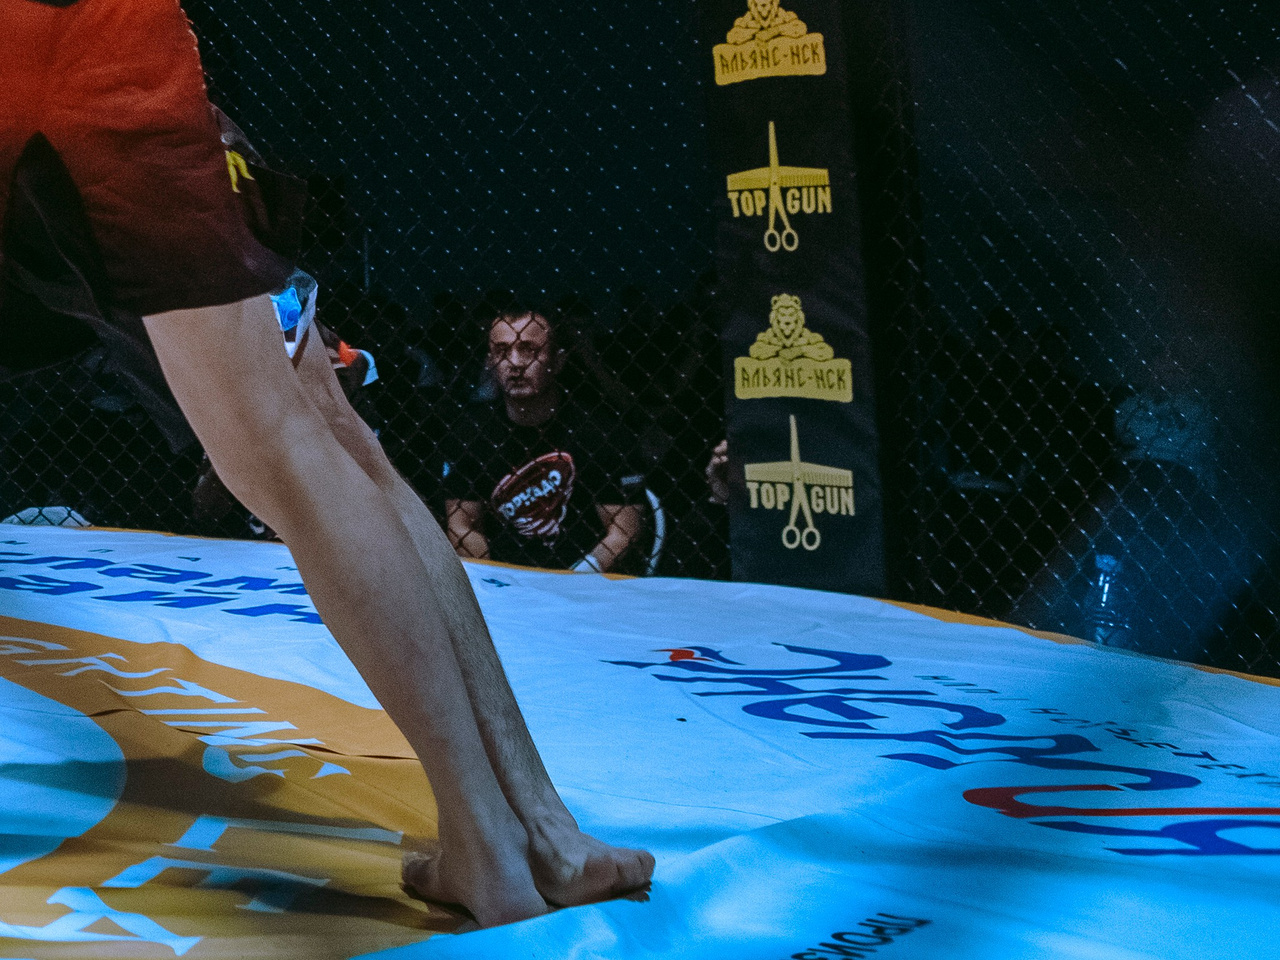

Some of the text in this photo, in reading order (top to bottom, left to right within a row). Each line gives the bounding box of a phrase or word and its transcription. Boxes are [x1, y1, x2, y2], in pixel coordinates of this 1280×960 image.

[719, 41, 821, 75] АЛЬЯНС-НСК
[727, 185, 833, 218] TOP GUN
[740, 366, 847, 390] АЛЬЯНС-НСК
[746, 481, 856, 517] TOP GUN
